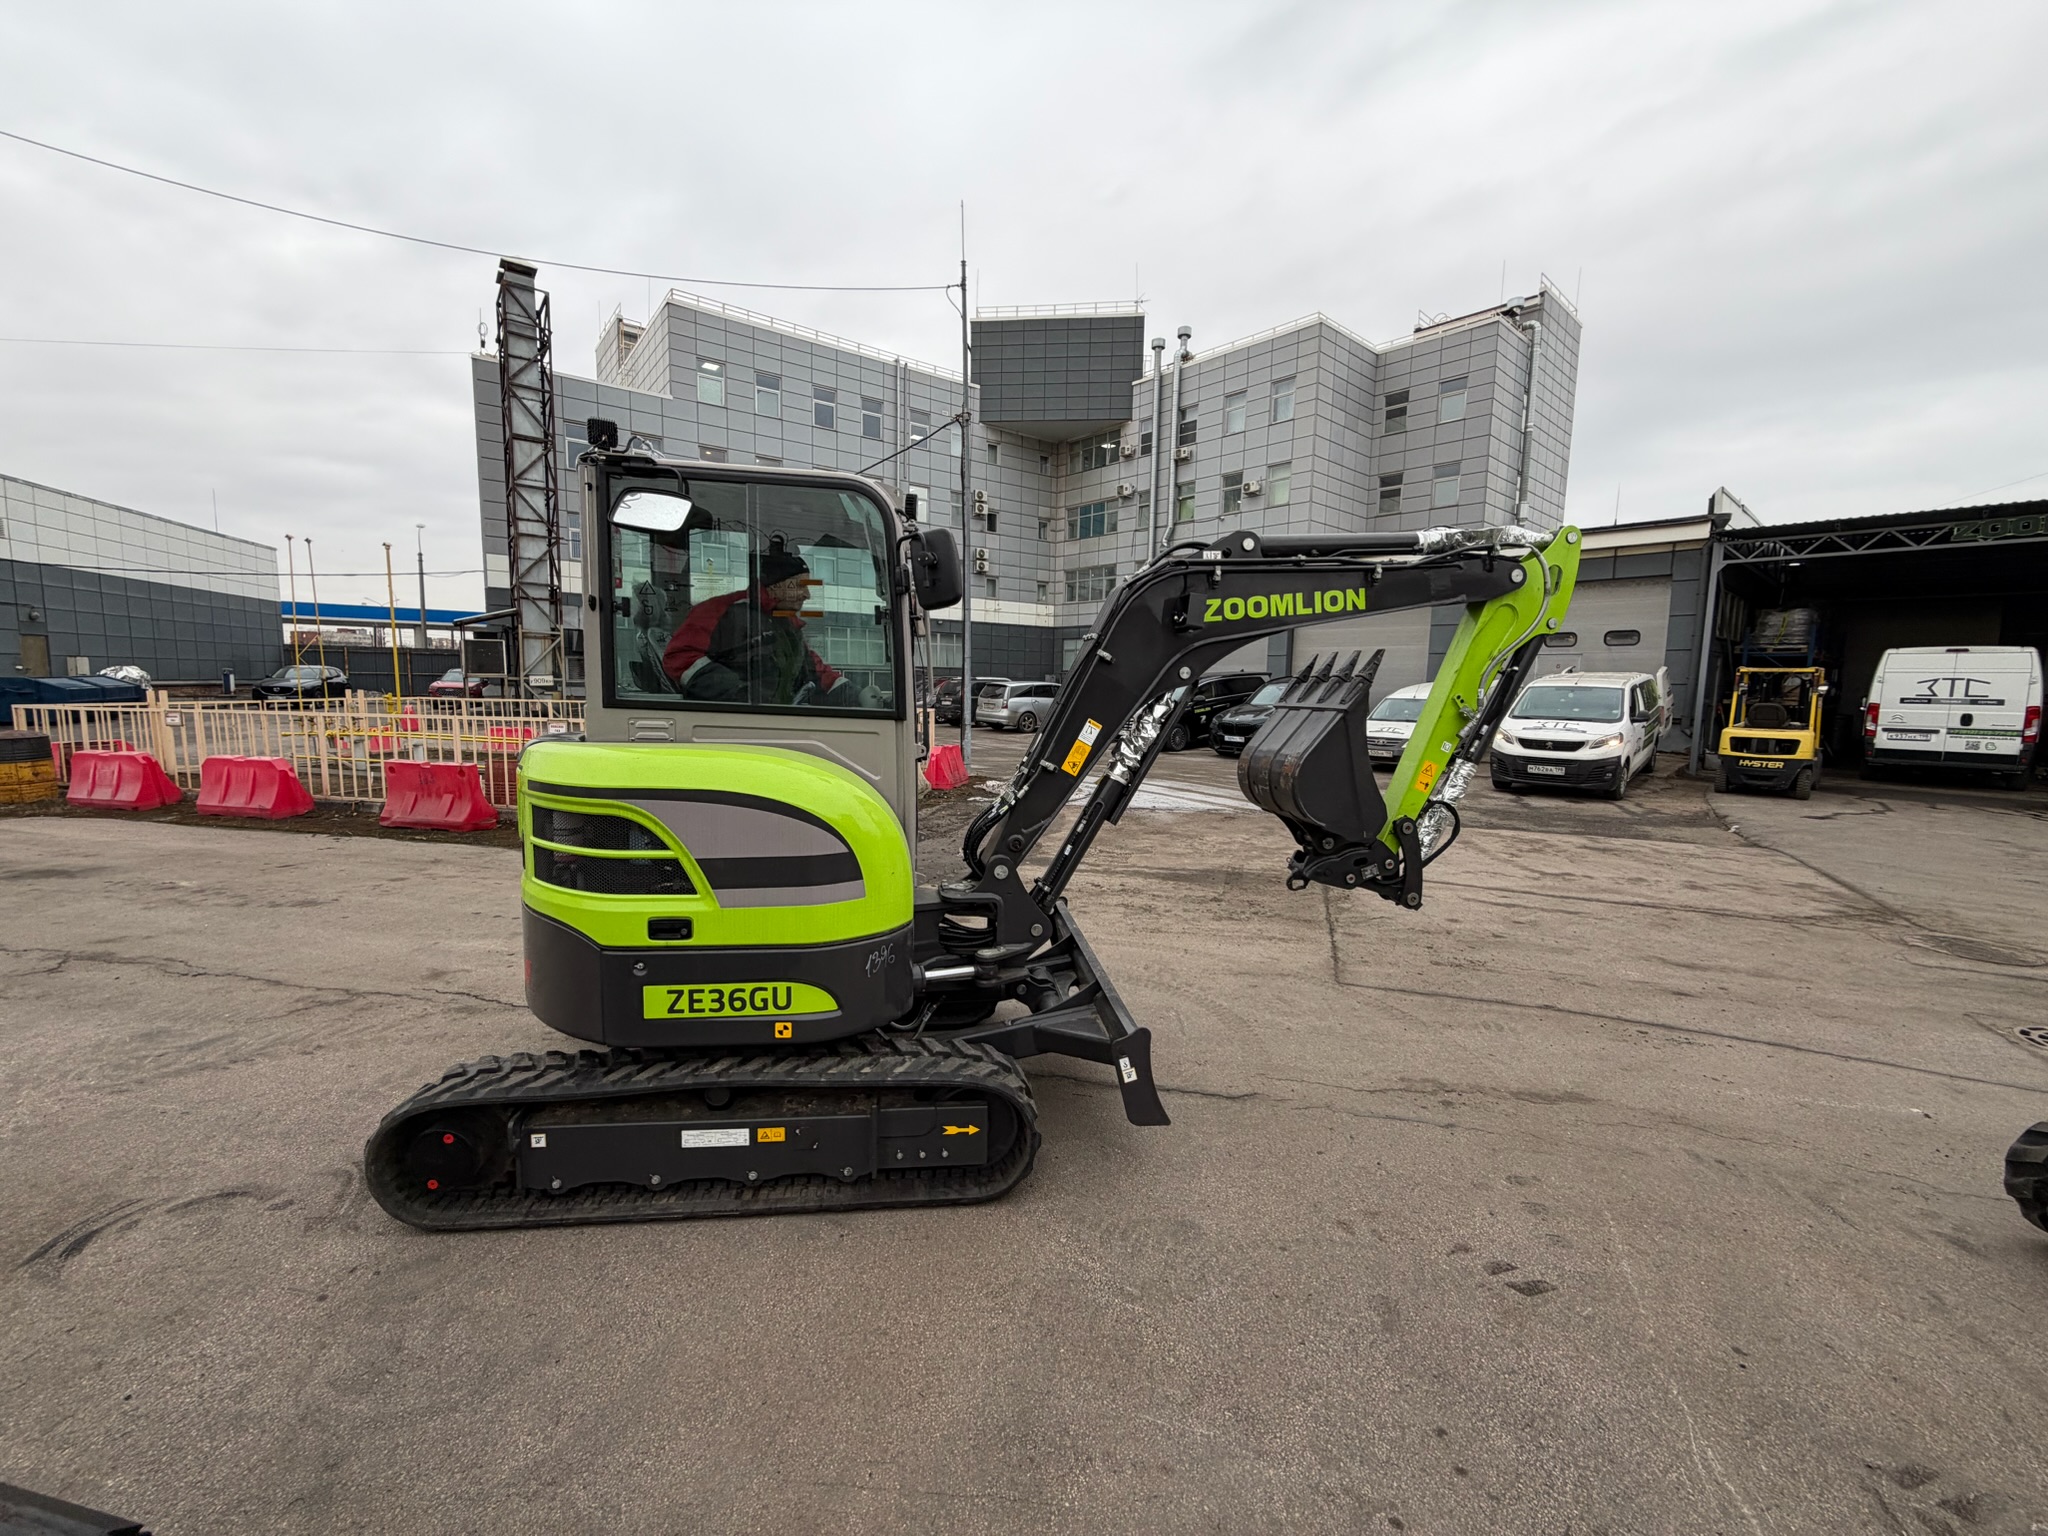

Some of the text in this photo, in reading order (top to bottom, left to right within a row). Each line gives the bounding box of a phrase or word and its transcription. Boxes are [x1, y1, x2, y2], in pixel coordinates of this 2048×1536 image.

[1203, 587, 1367, 623] ZOOMLION
[1739, 759, 1785, 769] HYSTER
[865, 943, 896, 978] 1396
[666, 986, 793, 1014] ZE36GU
